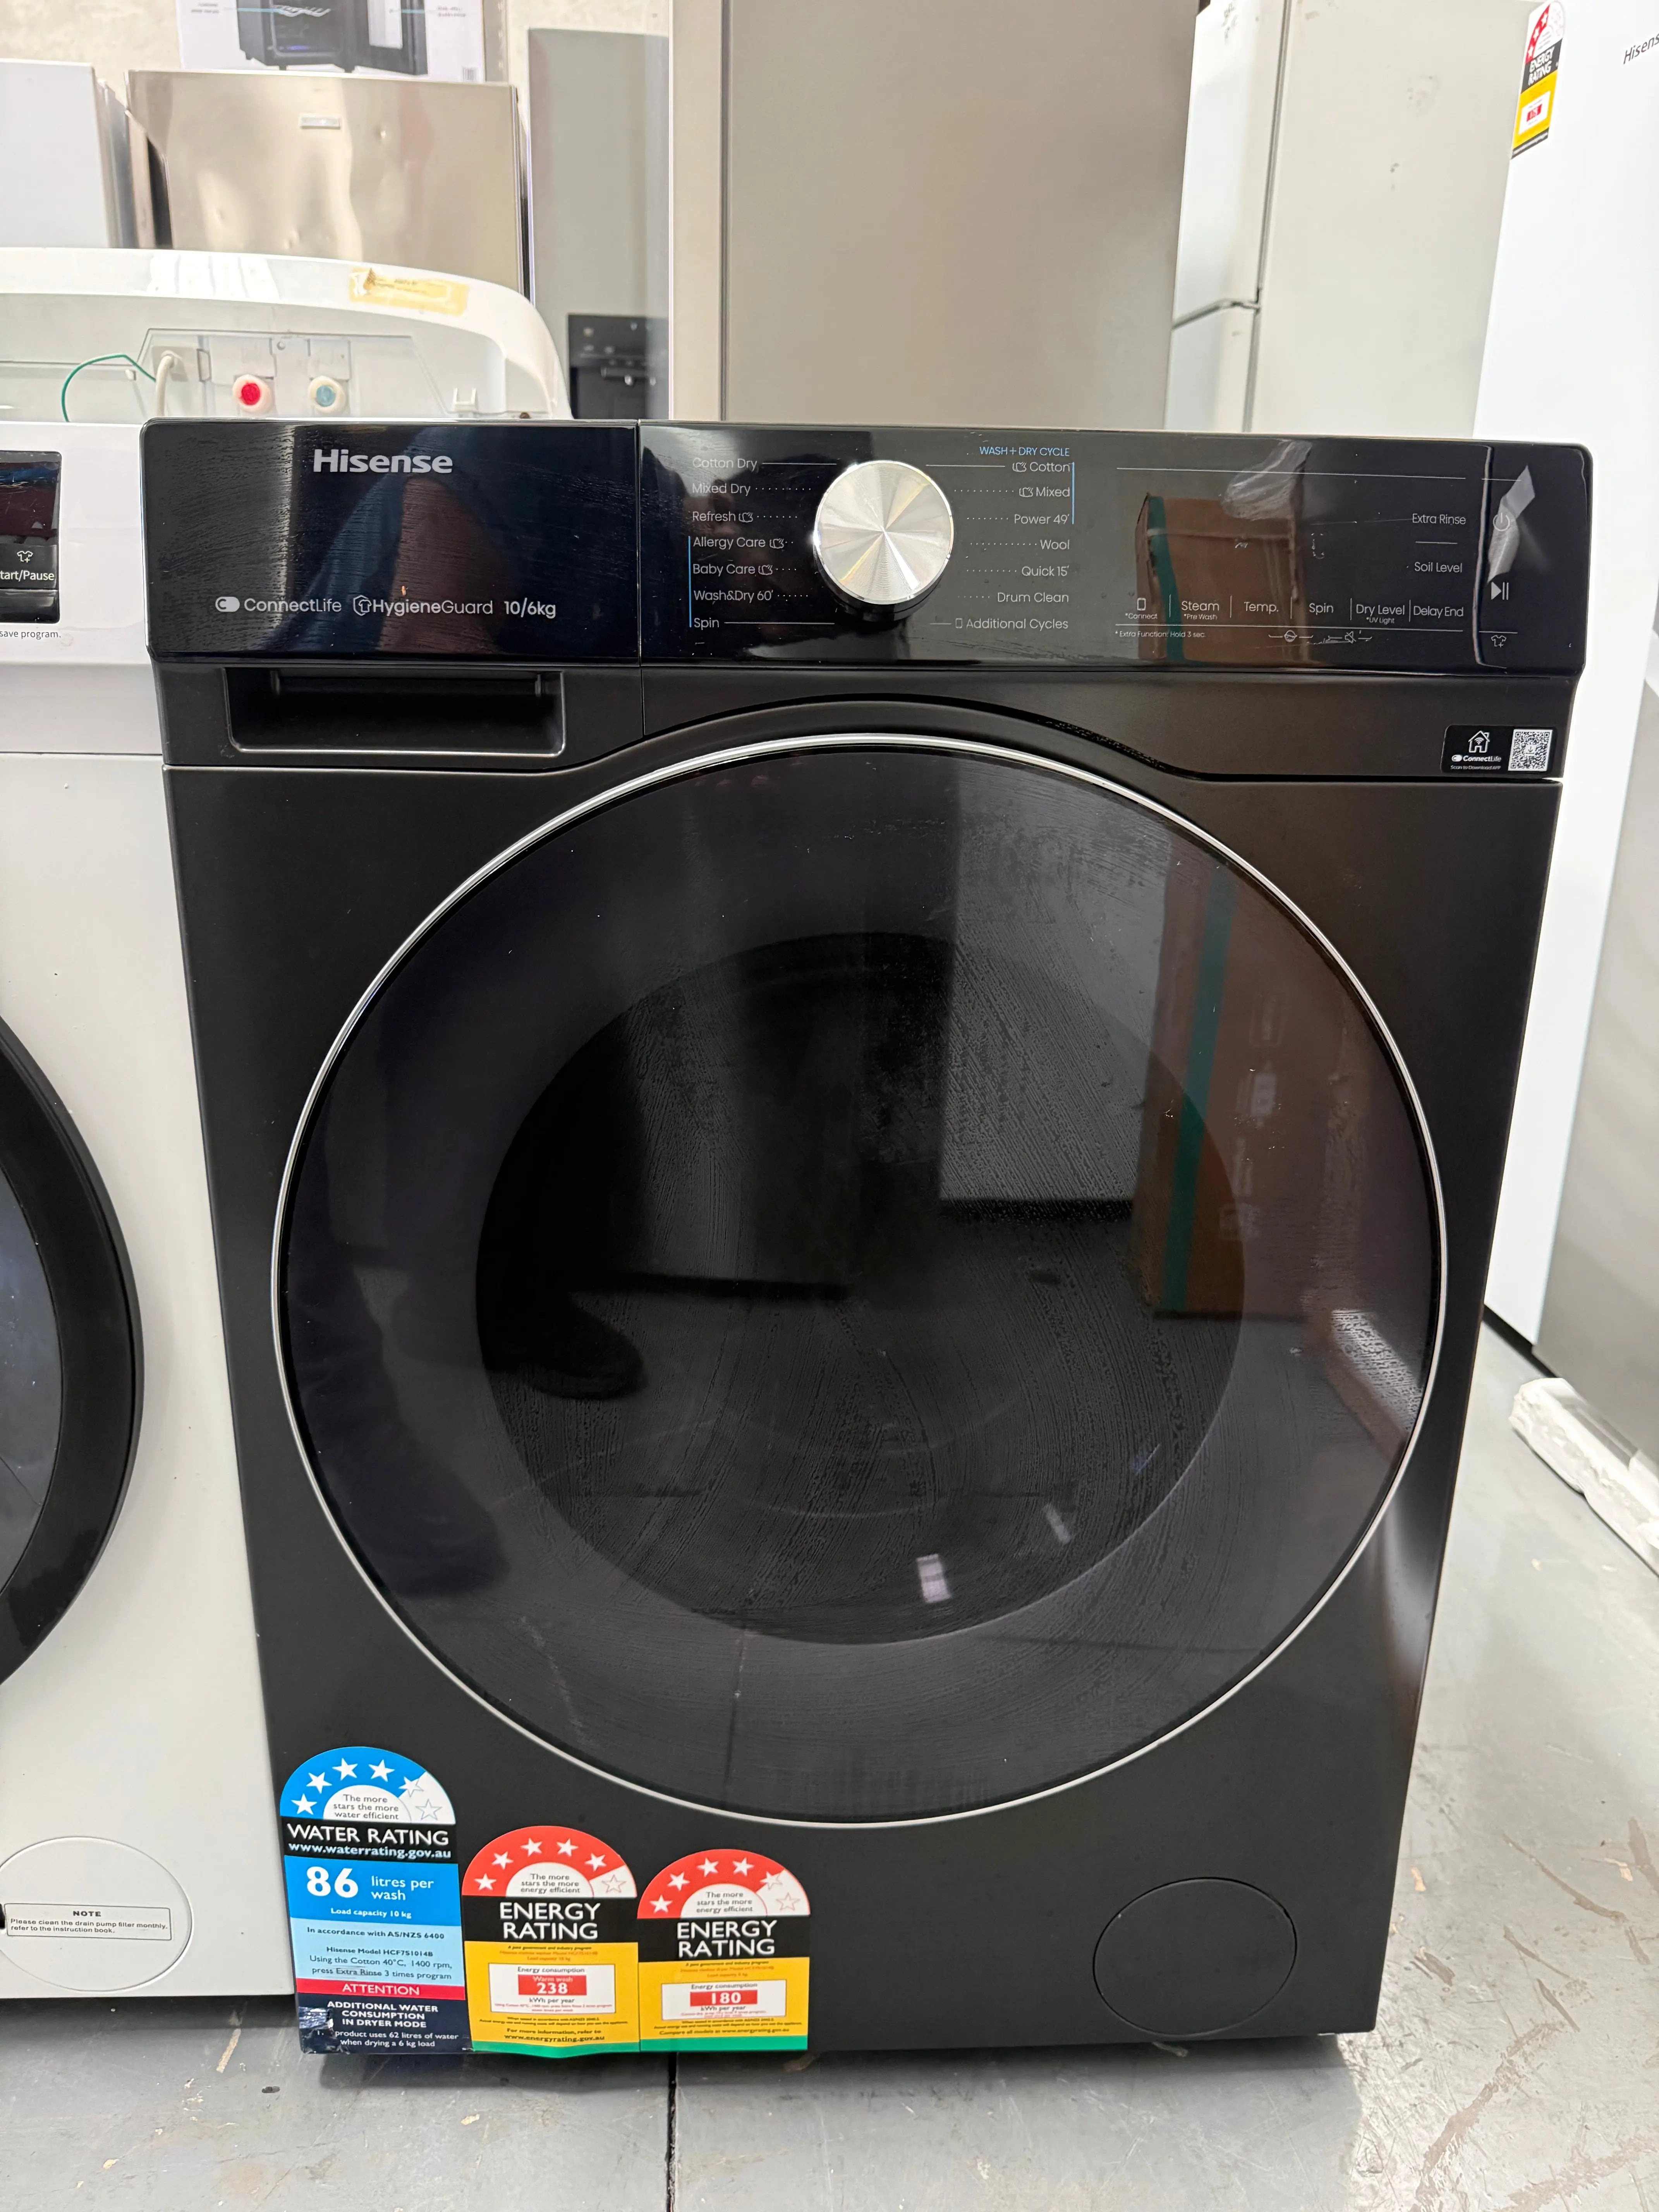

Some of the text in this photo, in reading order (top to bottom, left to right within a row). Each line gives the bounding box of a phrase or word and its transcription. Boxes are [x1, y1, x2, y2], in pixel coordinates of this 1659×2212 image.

[980, 447, 1007, 455] WASH
[1019, 447, 1037, 456] DRY
[1040, 448, 1070, 456] CYCLE
[313, 449, 453, 473] Hisense
[693, 458, 757, 472] Cotton Dry
[1030, 462, 1070, 472] Cotton
[692, 483, 750, 496] Mixed Dry
[1036, 487, 1070, 497] Mixed
[693, 511, 736, 521] Refresh
[1015, 514, 1051, 524] Power
[1412, 513, 1466, 524] Extra Rinse
[693, 537, 765, 550] Allergy Care
[1040, 539, 1070, 550] Wool
[693, 564, 755, 577] Baby Care
[1022, 566, 1054, 576] Quick
[1415, 562, 1462, 573] Soil Level
[694, 590, 754, 603] Wash&Dry
[998, 592, 1068, 602] Drum Clean
[244, 598, 556, 618] ConnectLife HygieneGuard 10/6kg
[1181, 601, 1219, 611] Steam
[1244, 602, 1279, 614] Temp.
[1309, 603, 1333, 615] Spin
[1357, 604, 1405, 617] Dry Level
[1413, 606, 1463, 618] Delay End
[694, 617, 719, 630] Spin
[967, 618, 1068, 631] Additional Cycles
[343, 1794, 361, 1802] The
[287, 1824, 449, 1846] WATER RATING
[289, 1843, 451, 1859] www.waterrating.gov.au
[307, 1866, 358, 1898] 86
[371, 1875, 434, 1891] litres per
[371, 1889, 405, 1900] wash
[353, 1909, 387, 1917] capacity
[500, 1902, 601, 1920] ENERGY
[503, 1922, 598, 1940] RATING
[677, 1920, 777, 1939] ENERGY
[678, 1939, 775, 1958] RATING
[310, 1955, 332, 1964] Using
[342, 1984, 419, 1995] ATTENTION
[537, 1982, 568, 1994] 238
[711, 1992, 741, 2004] 180
[327, 2001, 397, 2011] ADDITIONAL
[342, 2011, 424, 2020] CONSUMPTION
[335, 2030, 367, 2039] product
[365, 2040, 390, 2048] drying
